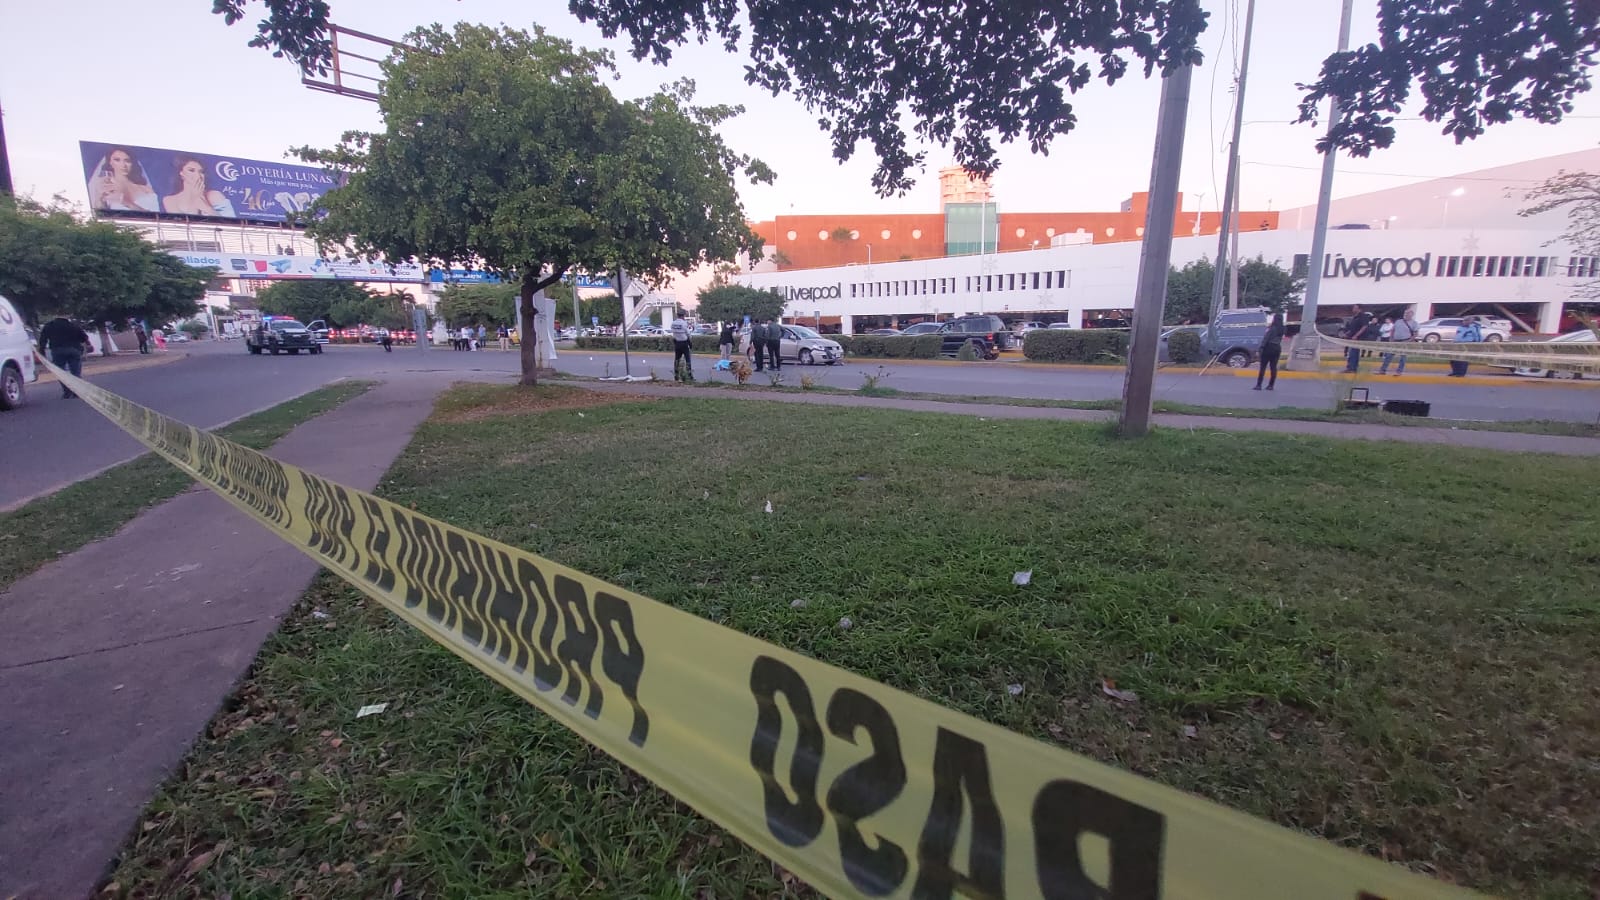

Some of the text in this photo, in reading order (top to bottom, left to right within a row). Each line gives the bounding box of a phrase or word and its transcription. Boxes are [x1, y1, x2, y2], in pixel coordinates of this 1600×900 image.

[241, 165, 333, 184] JOYERÍA LUNAS
[1322, 252, 1432, 282] Liverpool
[785, 281, 842, 302] Liverpool
